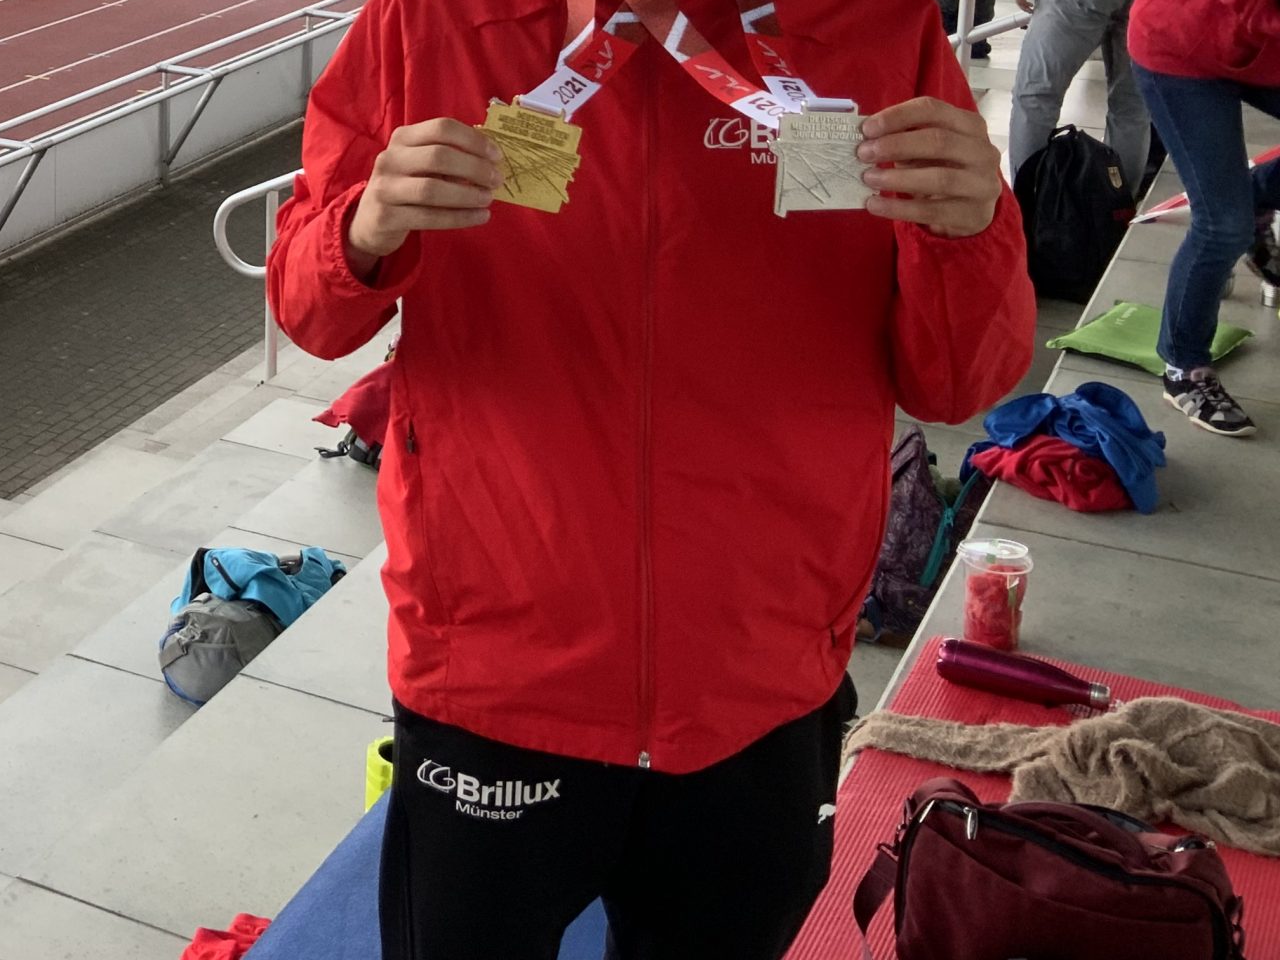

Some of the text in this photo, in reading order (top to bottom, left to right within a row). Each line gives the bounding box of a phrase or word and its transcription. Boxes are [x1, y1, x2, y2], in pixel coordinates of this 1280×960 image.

[552, 76, 588, 105] 2021
[807, 113, 850, 124] DEUTSCHE
[456, 772, 562, 808] Brillux
[455, 800, 524, 820] Münster
